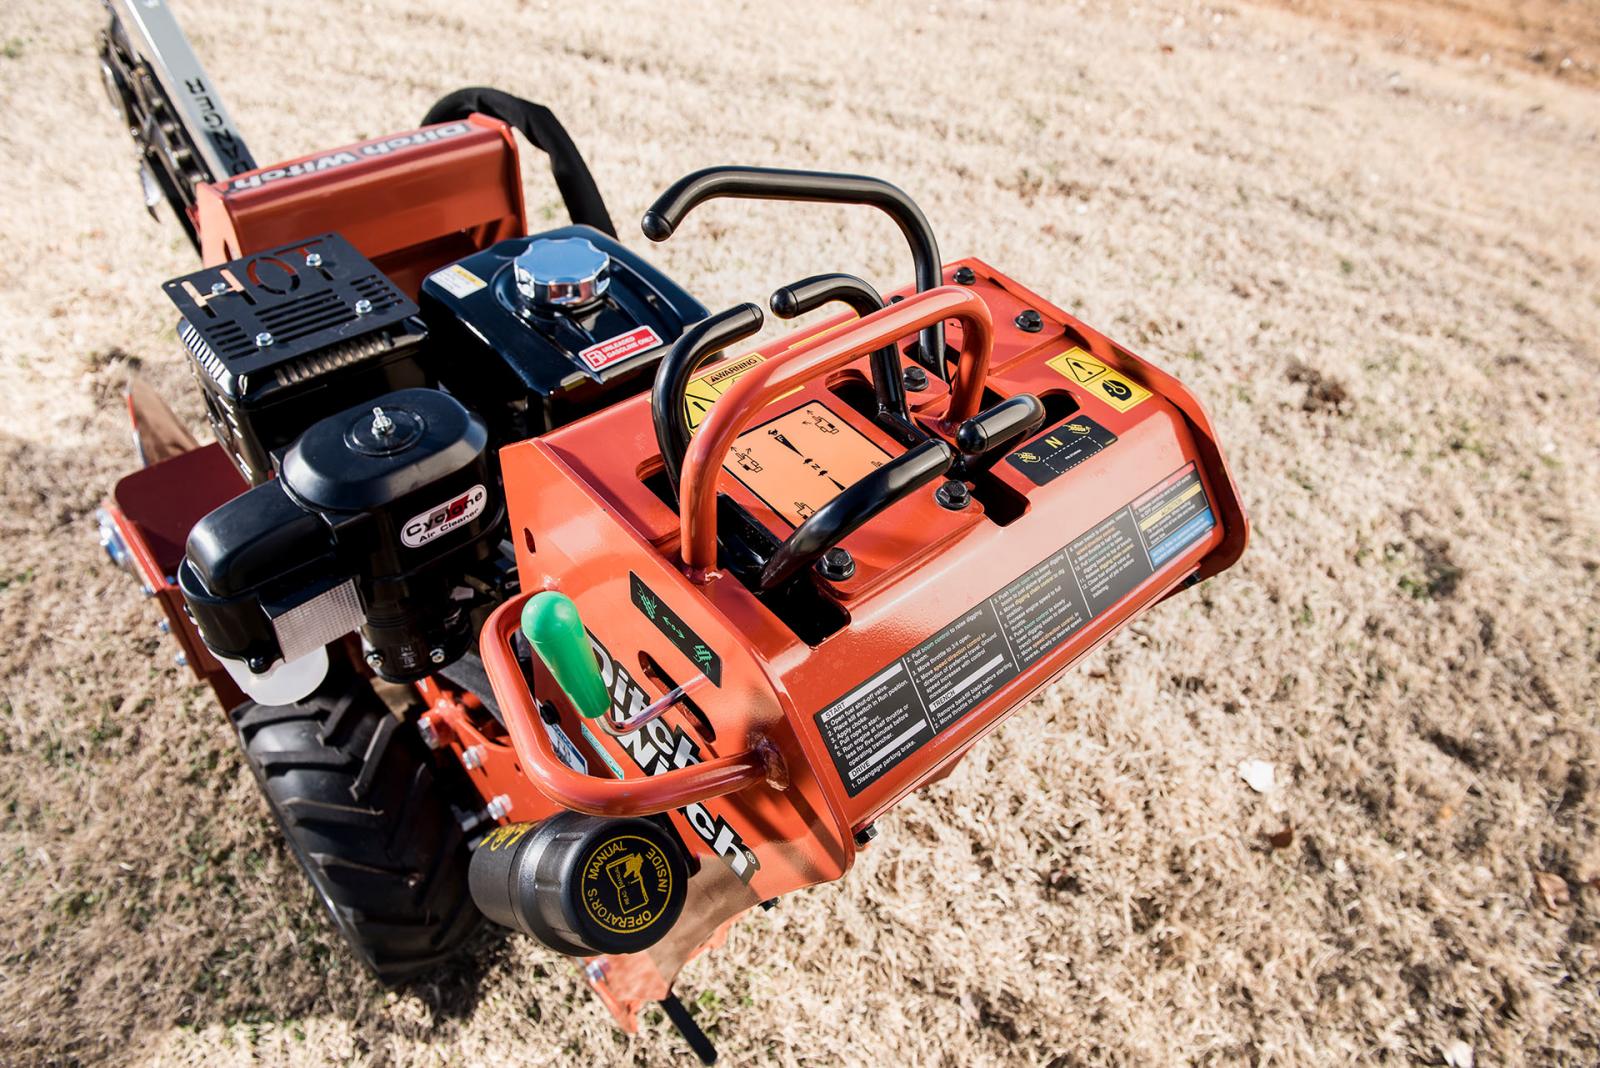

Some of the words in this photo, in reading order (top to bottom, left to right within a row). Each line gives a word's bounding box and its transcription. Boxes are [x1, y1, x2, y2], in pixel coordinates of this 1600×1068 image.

[362, 124, 470, 156] Ditch
[231, 153, 357, 190] Witch
[715, 358, 758, 380] WARNING
[1044, 436, 1064, 449] N
[406, 491, 483, 537] Cyclone
[419, 531, 436, 543] Air
[440, 508, 480, 532] Cleaner
[825, 701, 846, 719] START
[830, 713, 844, 726] Open
[844, 706, 854, 715] fuel
[854, 693, 873, 708] shut-off
[873, 683, 888, 695] valve.
[833, 719, 847, 732] Place
[847, 713, 855, 722] kill
[855, 702, 871, 716] switch
[877, 692, 887, 701] Run
[887, 678, 908, 695] position.
[932, 688, 955, 708] TRENCH
[835, 725, 851, 739] Apply
[851, 713, 868, 728] choke.
[839, 735, 849, 745] Pull
[849, 727, 861, 739] rope
[867, 713, 880, 725] start.
[845, 748, 856, 759] less
[856, 742, 864, 751] for
[863, 736, 873, 746] five
[873, 722, 892, 739] minutes
[892, 711, 908, 725] before
[851, 759, 870, 777] DRIVE
[856, 762, 883, 785] Disengage
[882, 749, 901, 766] parking
[900, 738, 915, 752] brake.
[588, 841, 628, 881] MANUAL
[645, 847, 668, 893] INSIDE
[588, 888, 652, 929] OPERATOR'S
